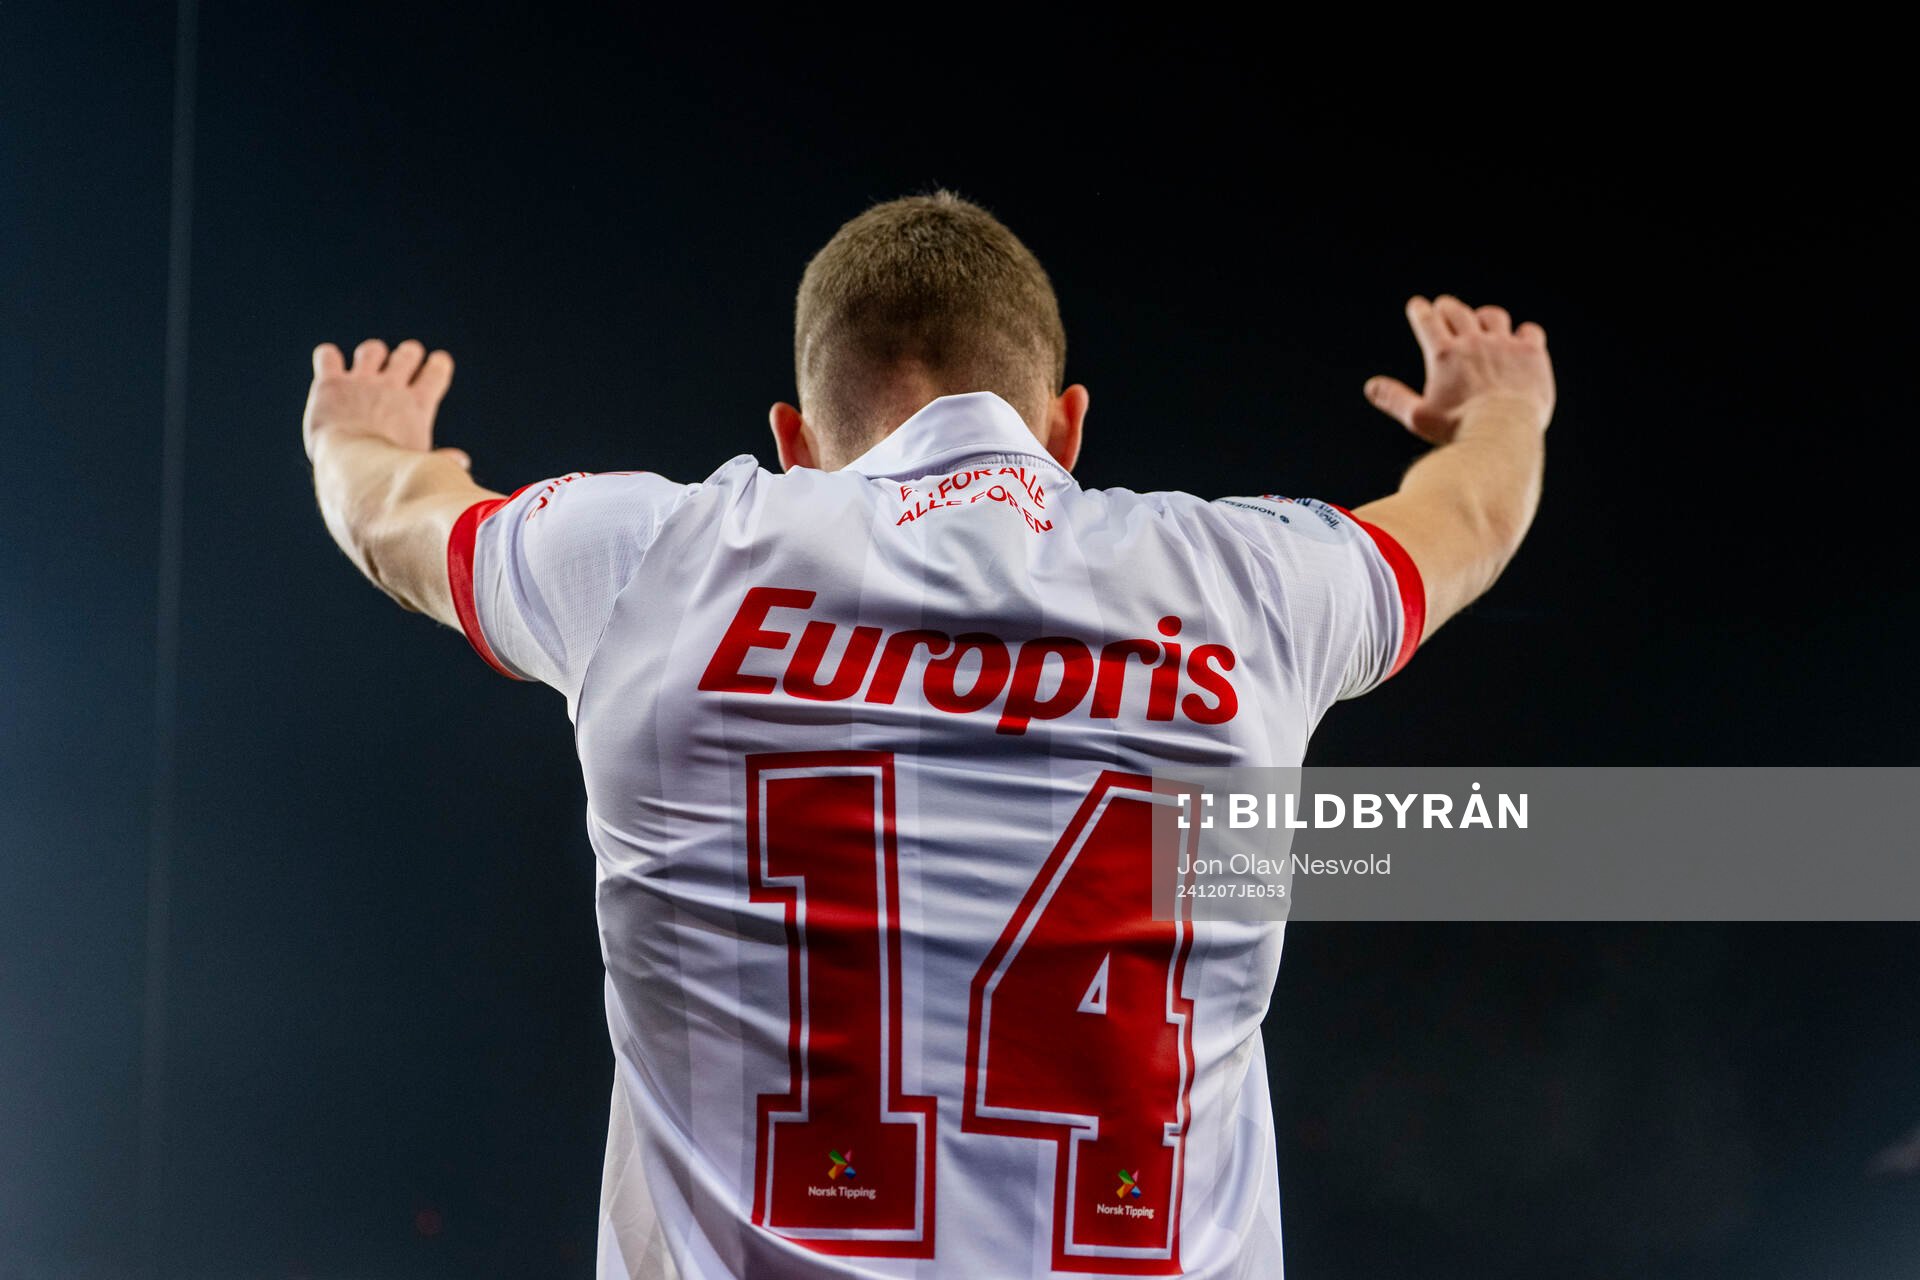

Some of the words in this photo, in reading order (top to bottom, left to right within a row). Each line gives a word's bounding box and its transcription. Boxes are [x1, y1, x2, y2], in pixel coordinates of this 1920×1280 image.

[938, 470, 992, 499] FOR
[999, 467, 1045, 509] ALLE
[896, 501, 962, 526] ALLE
[1022, 507, 1053, 534] EN
[697, 586, 1239, 736] Europris
[745, 750, 1204, 1275] 14
[808, 1186, 837, 1197] Norsk
[838, 1186, 876, 1200] Tipping
[1097, 1203, 1124, 1216] Norsk
[1125, 1204, 1154, 1220] Tipping
